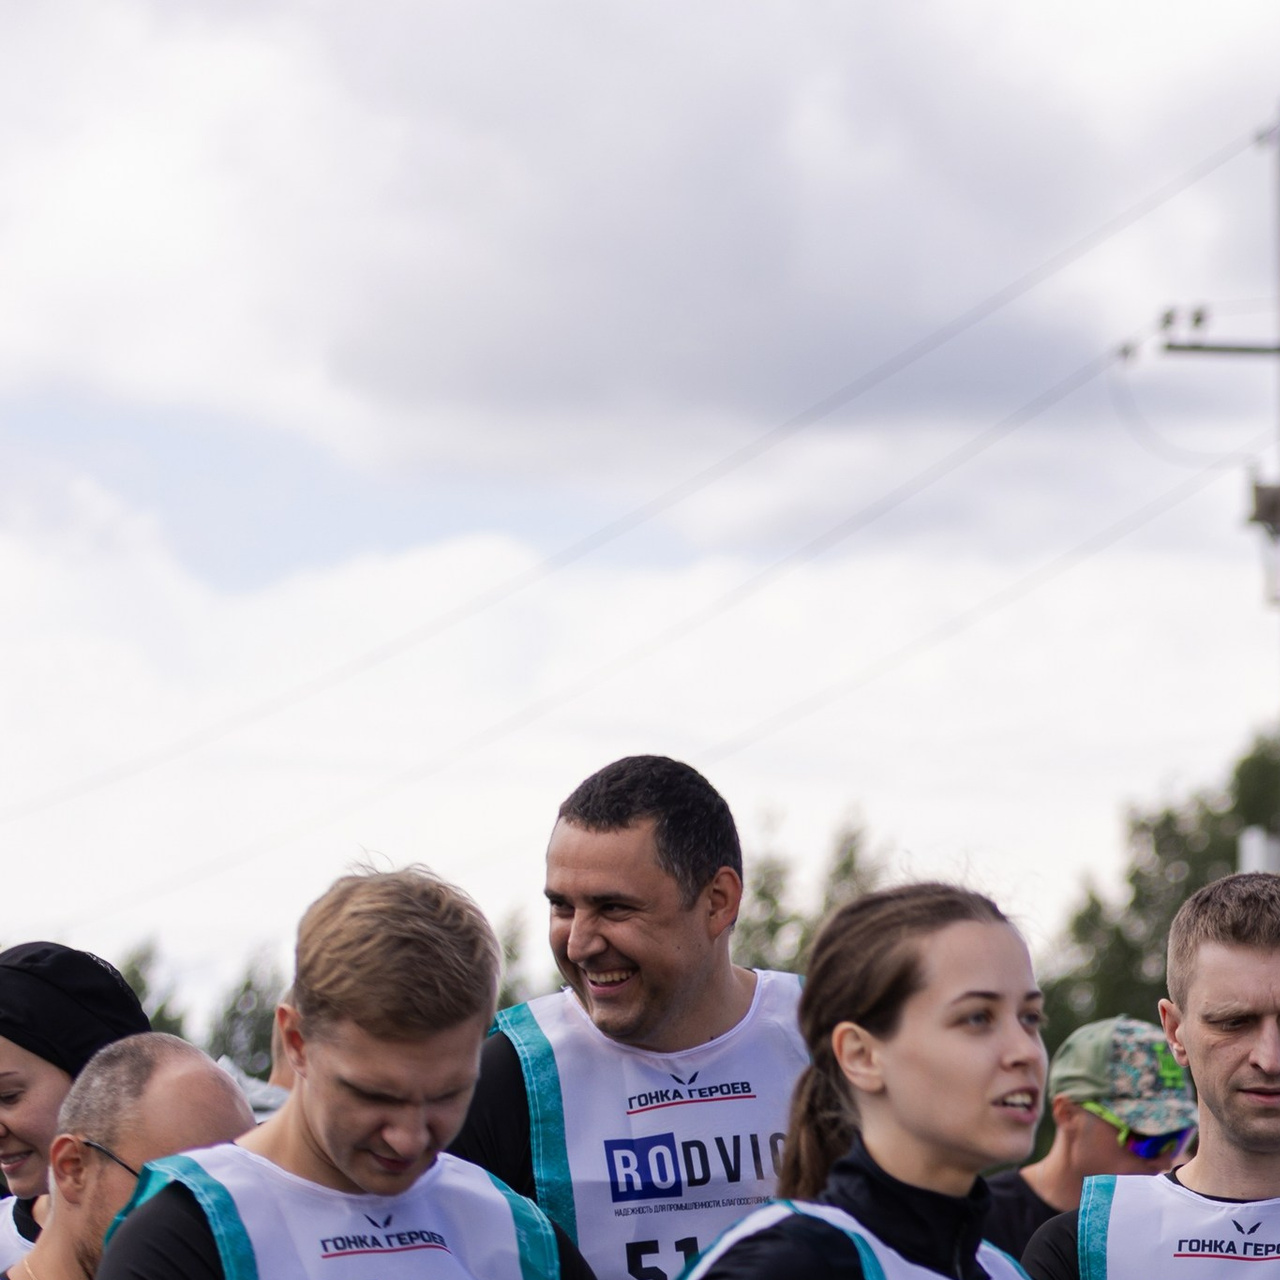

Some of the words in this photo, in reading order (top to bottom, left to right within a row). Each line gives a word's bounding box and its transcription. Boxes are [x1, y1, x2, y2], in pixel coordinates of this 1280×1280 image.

[628, 1088, 684, 1110] ГОНКА
[687, 1081, 752, 1099] ГЕРОЕВ
[320, 1232, 384, 1253] ГОНКА
[1178, 1238, 1237, 1255] ГОНКА
